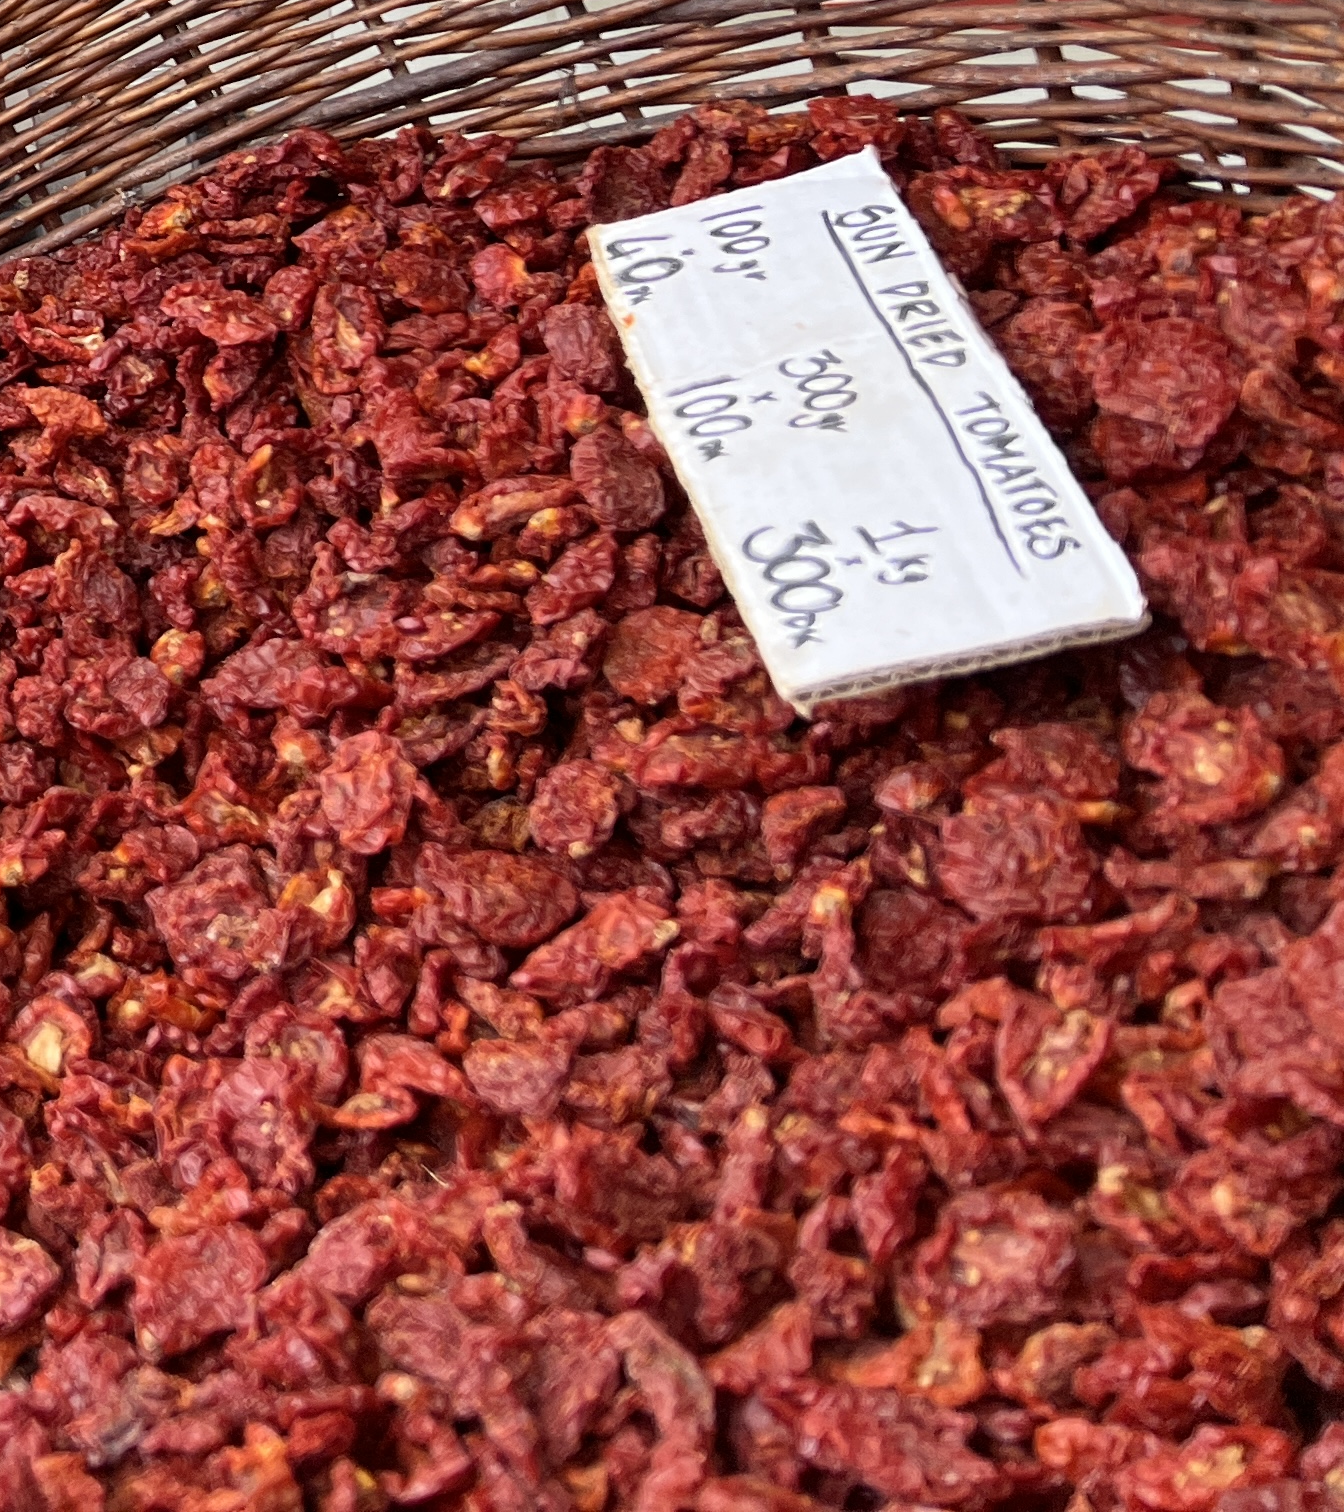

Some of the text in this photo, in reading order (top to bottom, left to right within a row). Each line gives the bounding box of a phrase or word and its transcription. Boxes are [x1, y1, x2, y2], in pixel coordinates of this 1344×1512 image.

[834, 204, 1083, 561] SUN DRIED TOMATOES
